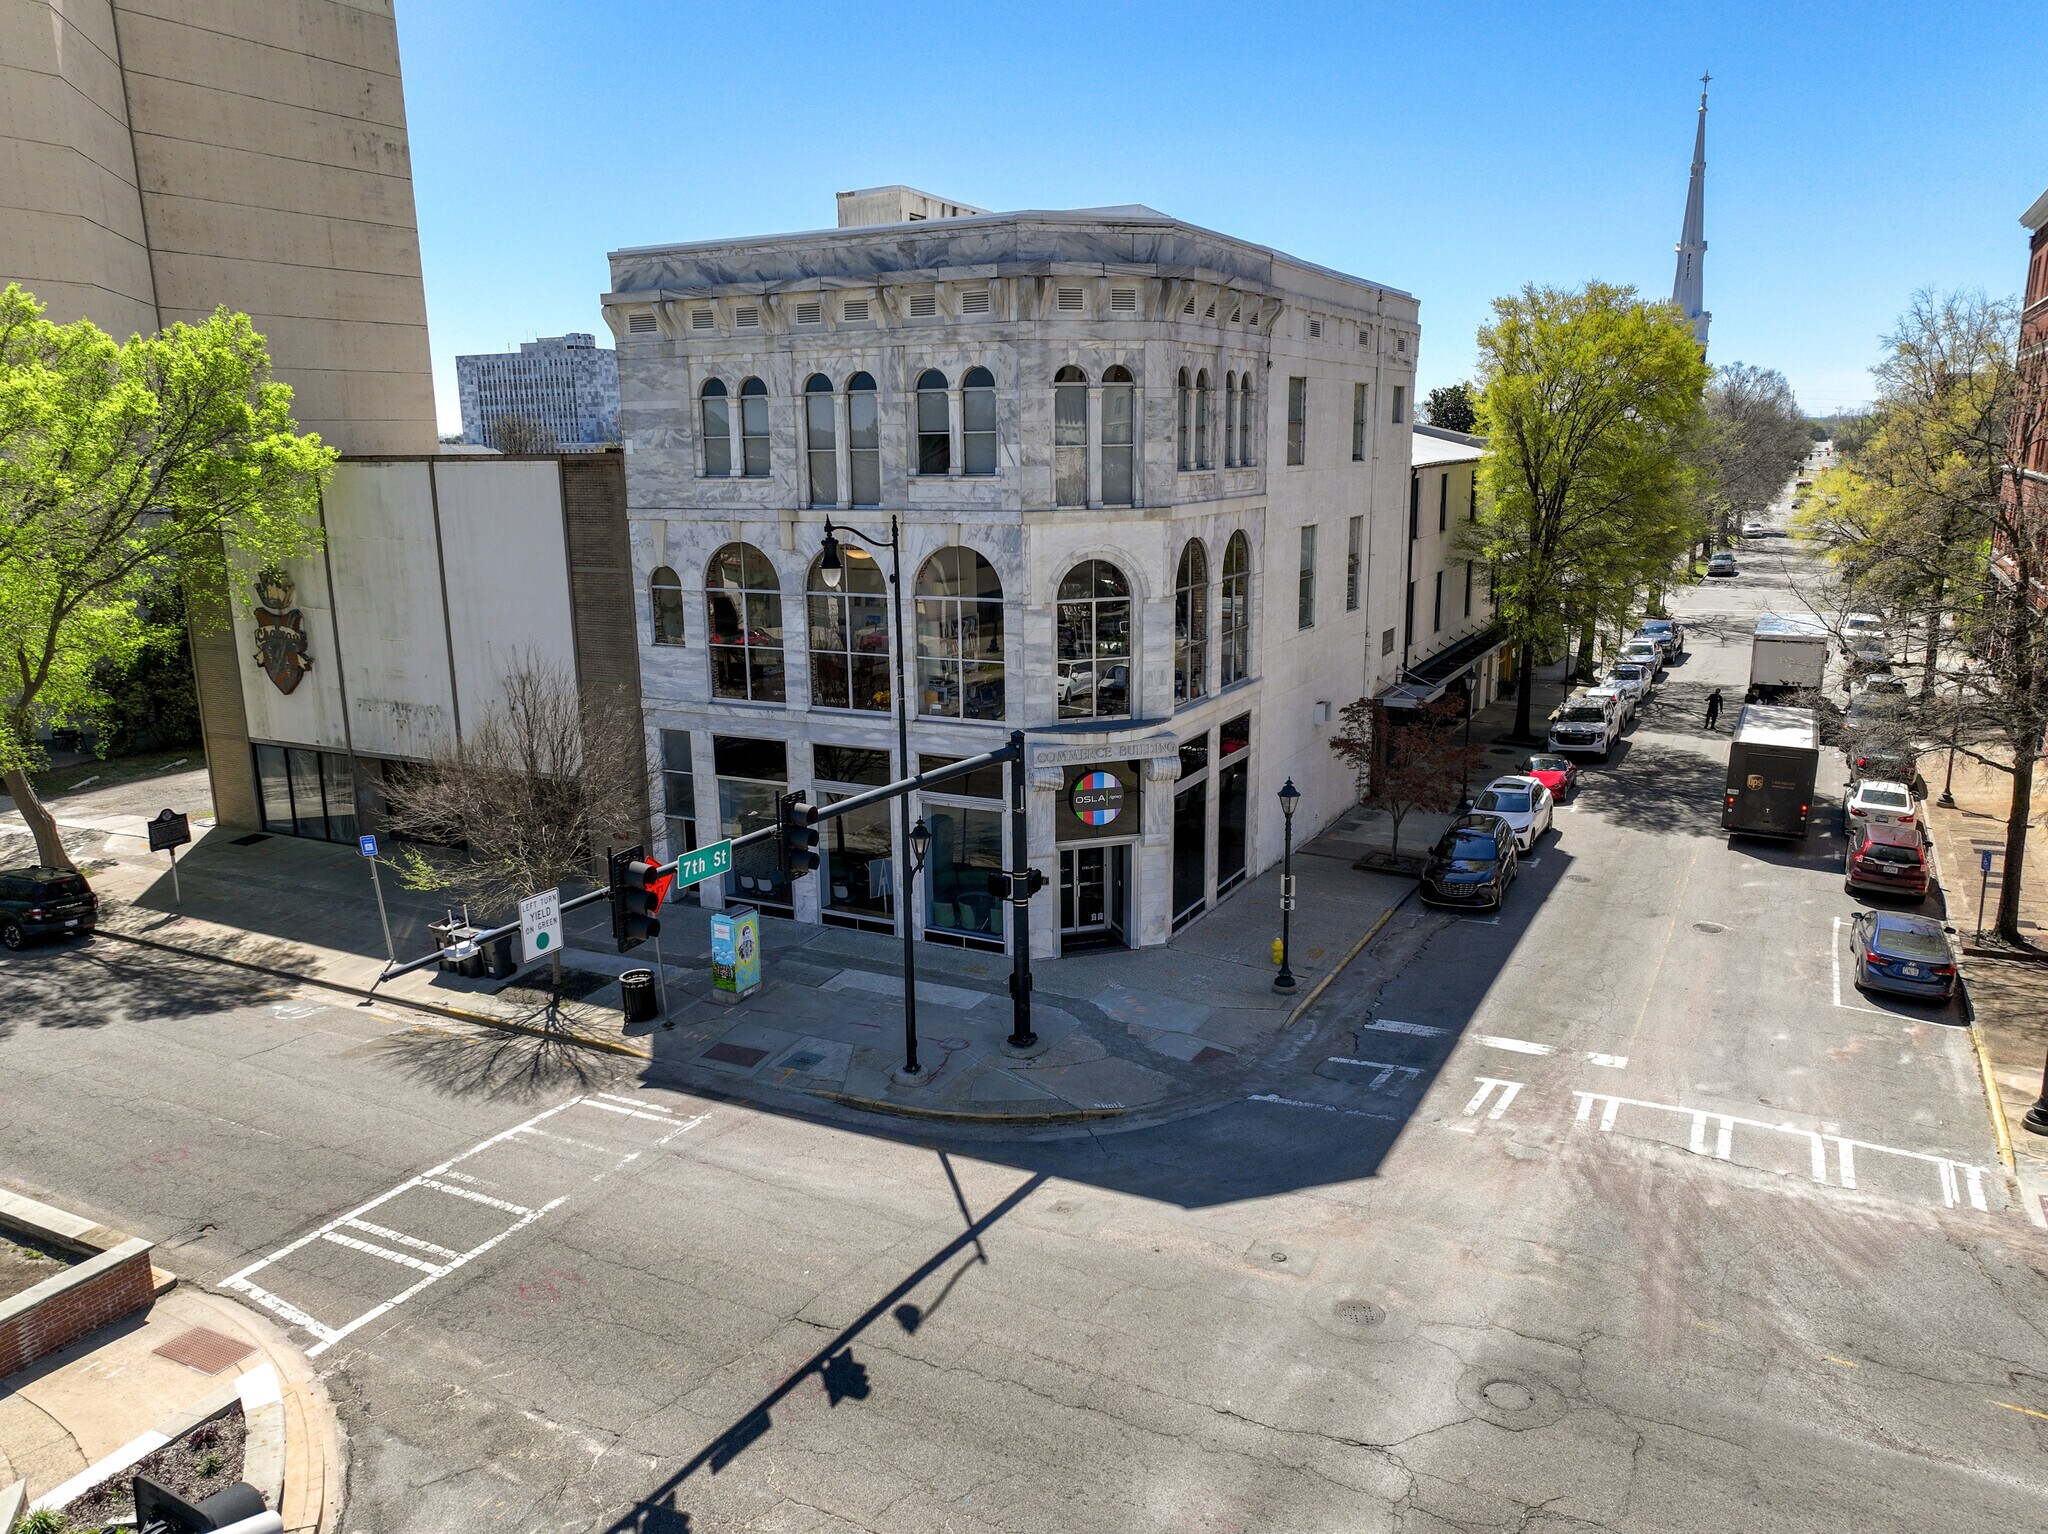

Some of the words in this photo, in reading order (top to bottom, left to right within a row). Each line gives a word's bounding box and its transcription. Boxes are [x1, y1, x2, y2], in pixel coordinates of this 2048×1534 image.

[1037, 747, 1113, 763] COMMERCE
[1119, 742, 1176, 757] BUILDING
[1075, 795, 1106, 804] OSLA
[683, 857, 706, 878] 7th
[713, 849, 727, 867] St
[521, 901, 537, 913] LEFT
[540, 894, 557, 906] TURN
[529, 907, 551, 922] YIELD
[525, 926, 535, 935] ON
[538, 917, 558, 930] GREEN
